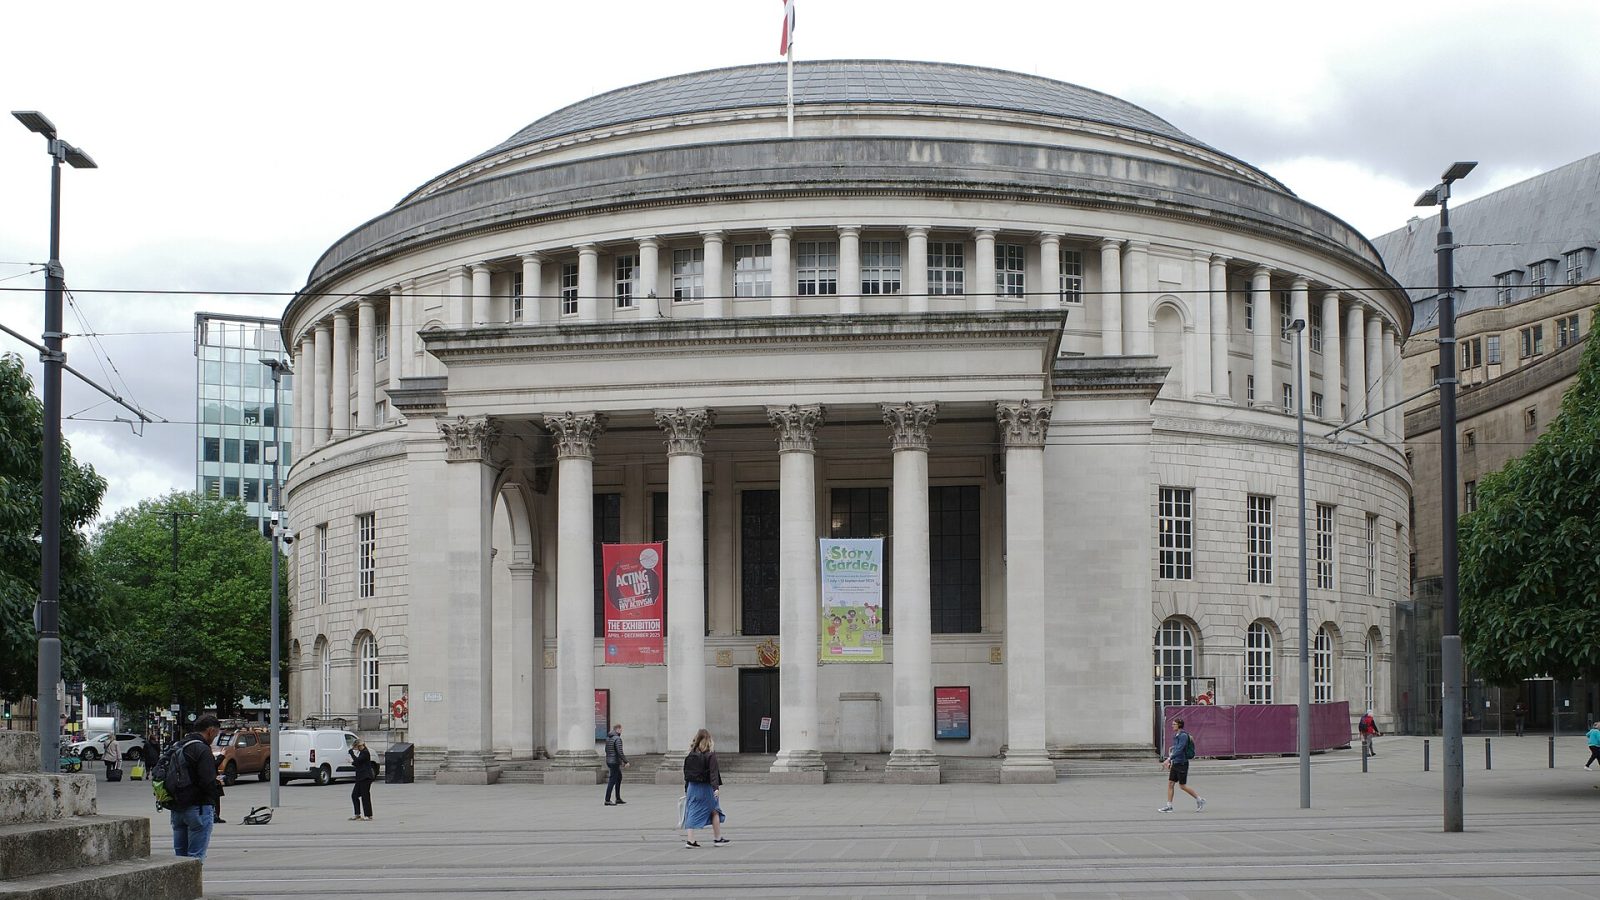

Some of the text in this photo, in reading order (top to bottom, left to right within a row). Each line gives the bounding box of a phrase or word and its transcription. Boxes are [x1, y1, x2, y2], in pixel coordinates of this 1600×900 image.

[831, 546, 872, 560] Story
[826, 559, 878, 572] Garden
[616, 570, 648, 587] ACTING
[634, 582, 650, 595] UP!
[608, 621, 660, 630] THE EXHIBITION
